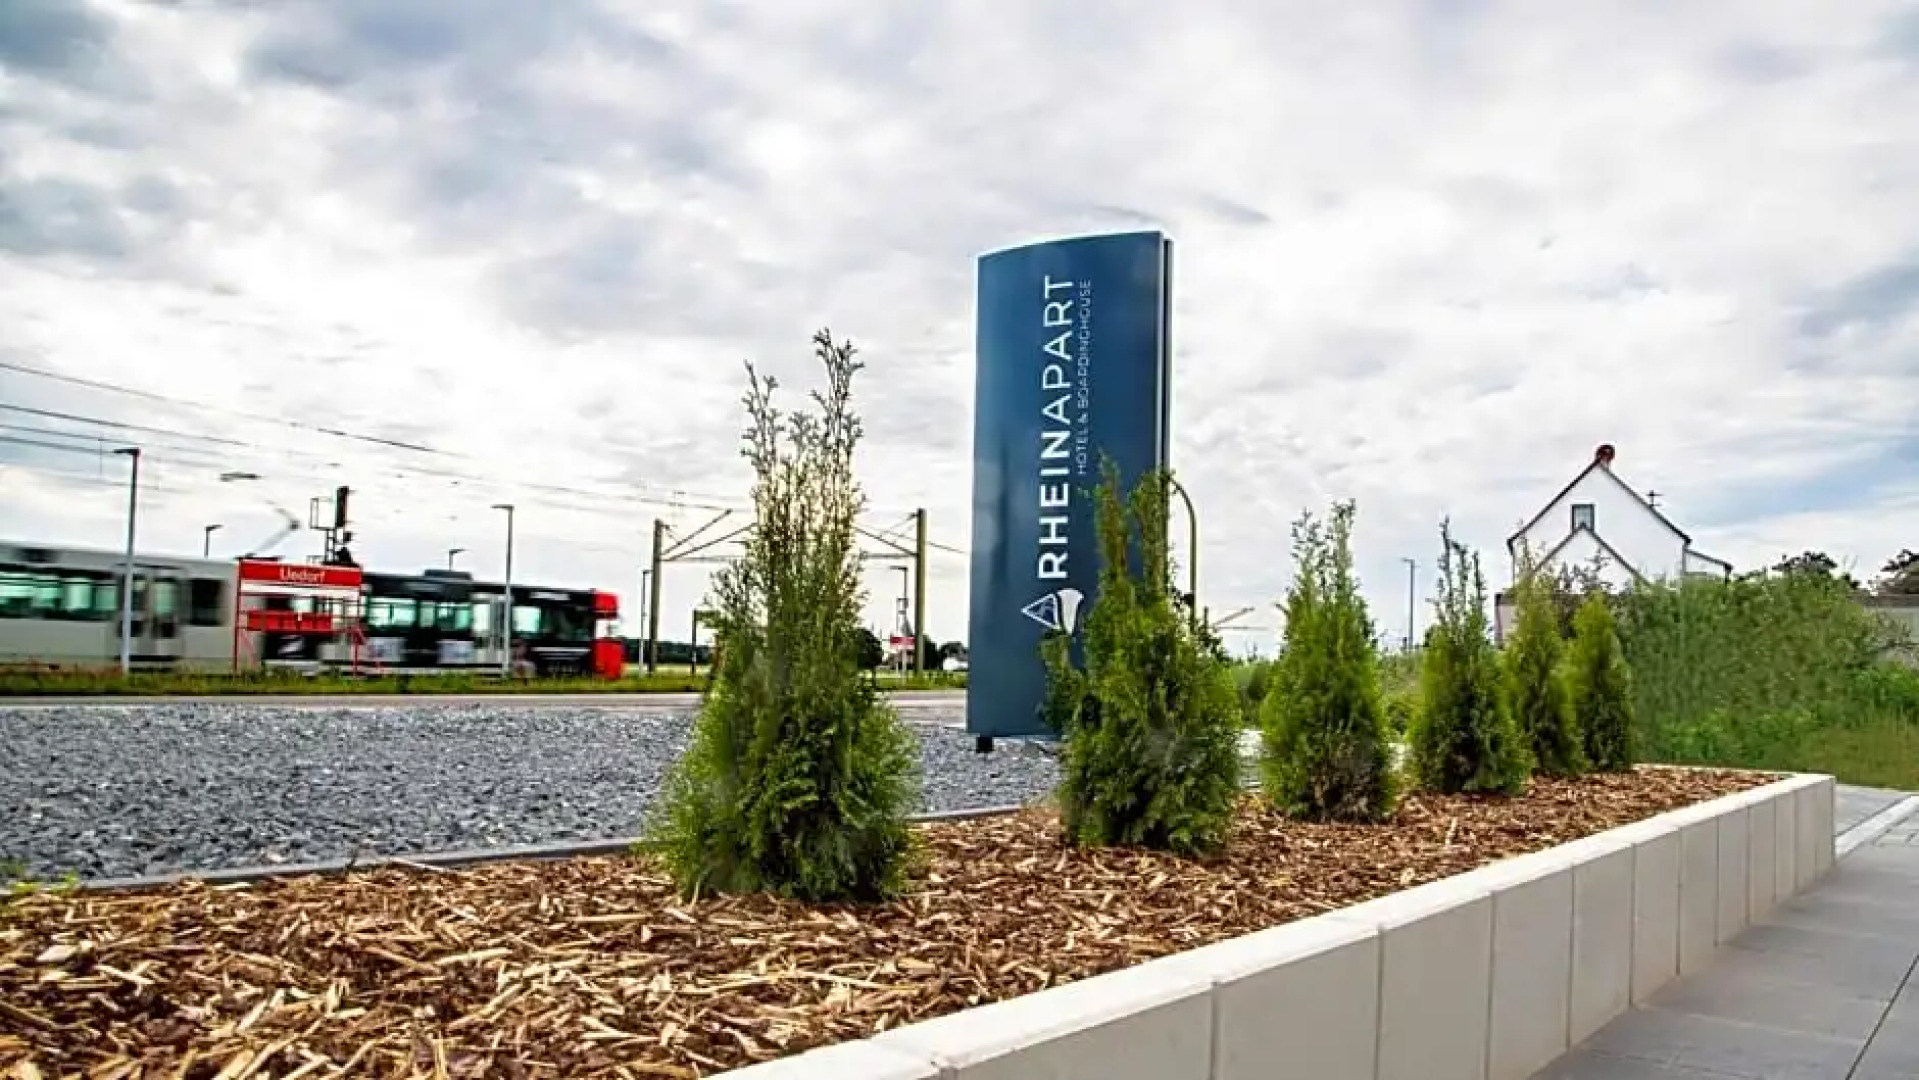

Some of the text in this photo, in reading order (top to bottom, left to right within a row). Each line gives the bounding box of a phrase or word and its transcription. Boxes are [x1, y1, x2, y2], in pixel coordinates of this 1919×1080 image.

[1077, 279, 1091, 409] BOARDINGHOUSE
[1038, 275, 1075, 579] RHEINAPART
[1076, 427, 1089, 475] HOTEL
